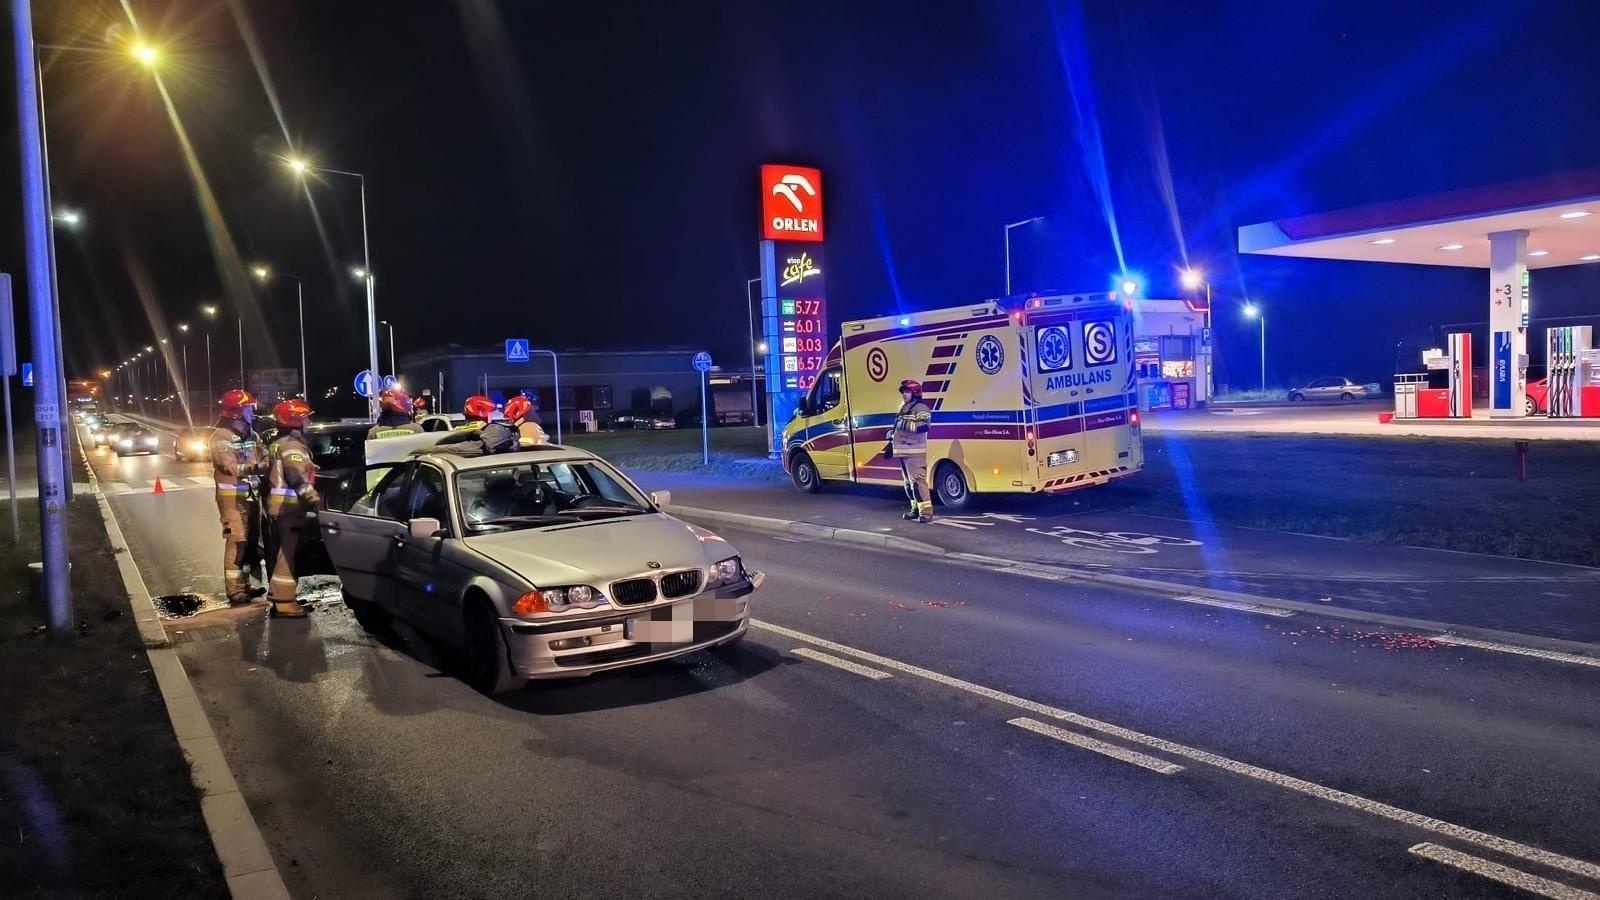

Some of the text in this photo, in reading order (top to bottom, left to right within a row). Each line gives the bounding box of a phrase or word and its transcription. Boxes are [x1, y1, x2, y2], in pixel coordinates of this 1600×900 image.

[773, 217, 818, 232] ORLEN
[1504, 284, 1511, 295] 3
[796, 301, 820, 314] 5.77
[1507, 297, 1511, 307] 1
[796, 320, 821, 333] 6.01
[1094, 330, 1107, 354] S
[798, 357, 822, 370] 6.57
[872, 353, 883, 376] S
[799, 376, 816, 389] 6.2
[1046, 369, 1112, 390] AMBULANS
